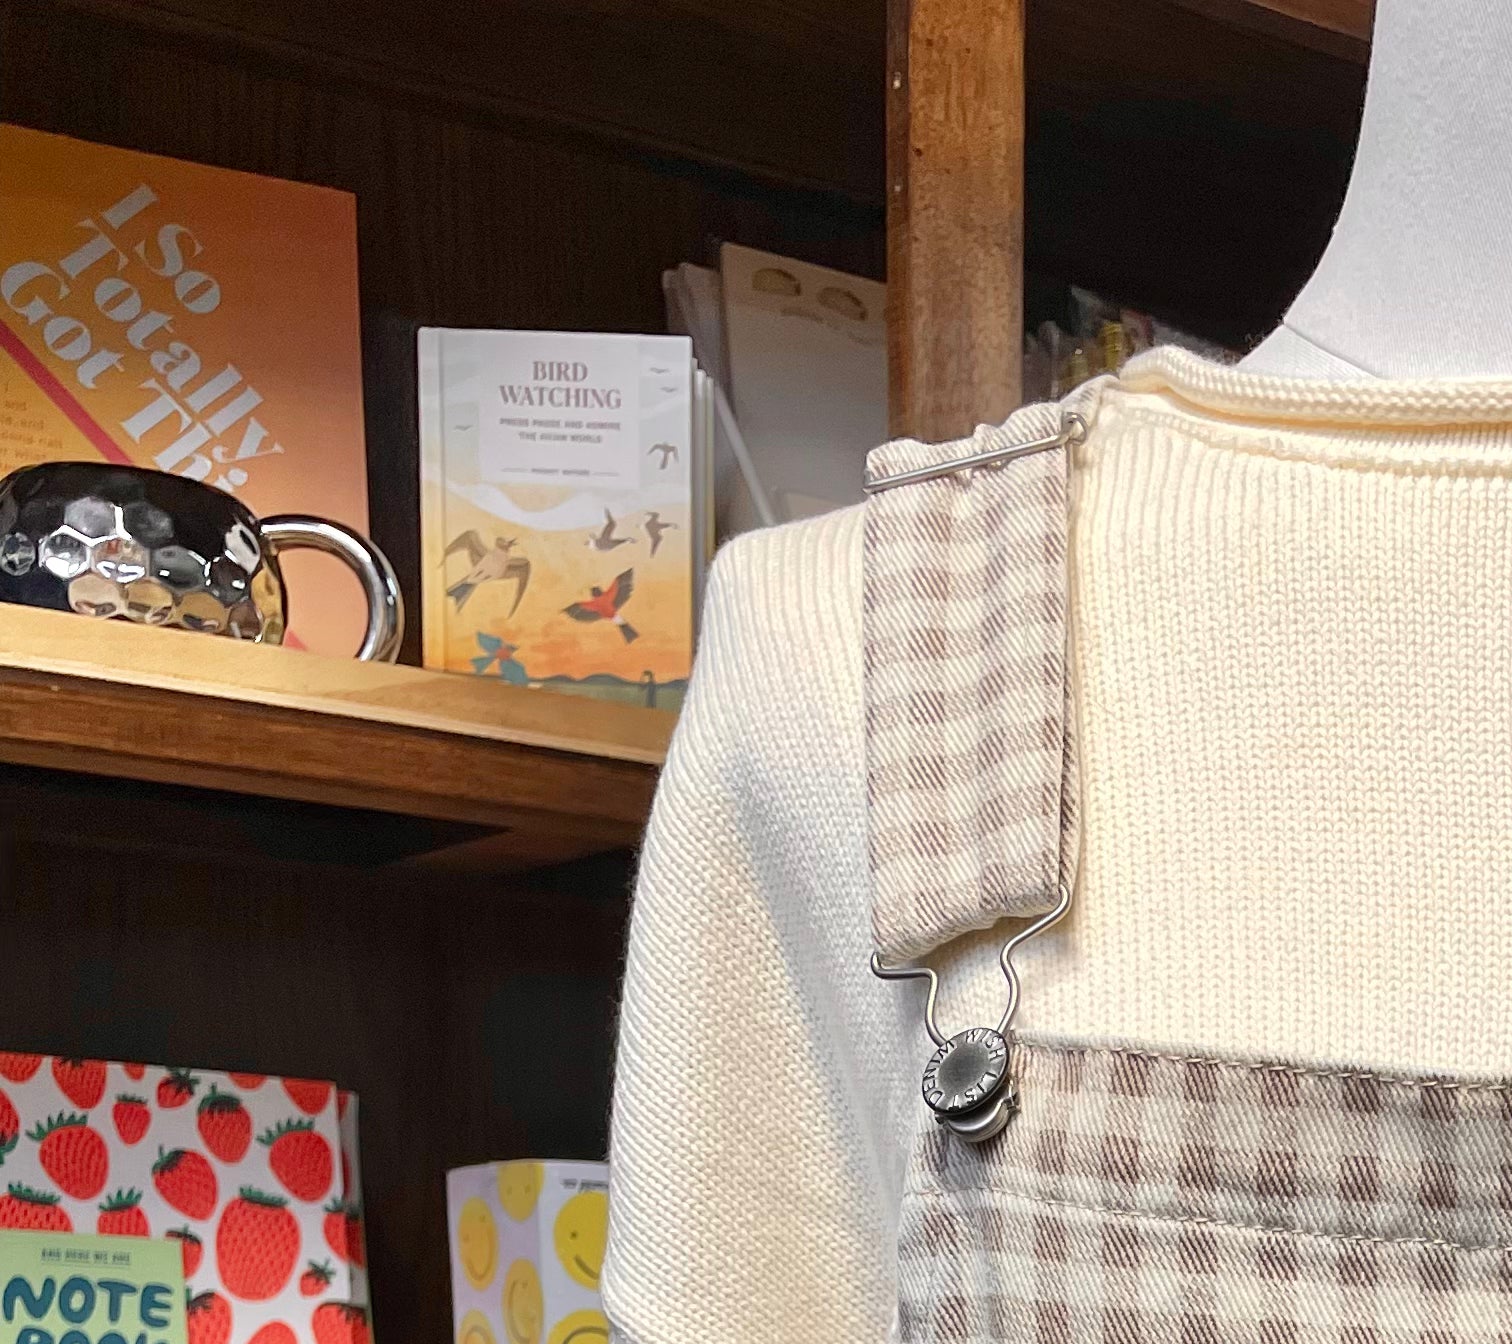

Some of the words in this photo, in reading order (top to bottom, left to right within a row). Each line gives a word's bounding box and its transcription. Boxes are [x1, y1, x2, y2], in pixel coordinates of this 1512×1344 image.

[103, 183, 159, 230] I
[134, 224, 221, 314] So
[59, 218, 285, 462] Totally
[1, 261, 124, 389] Got
[120, 379, 248, 493] Th
[499, 385, 622, 409] WATCHING
[532, 361, 588, 382] BIRD
[965, 1028, 1006, 1062] WISH
[922, 1040, 955, 1107] DENIM
[947, 1071, 998, 1113] LIST
[3, 1275, 174, 1328] NOTE
